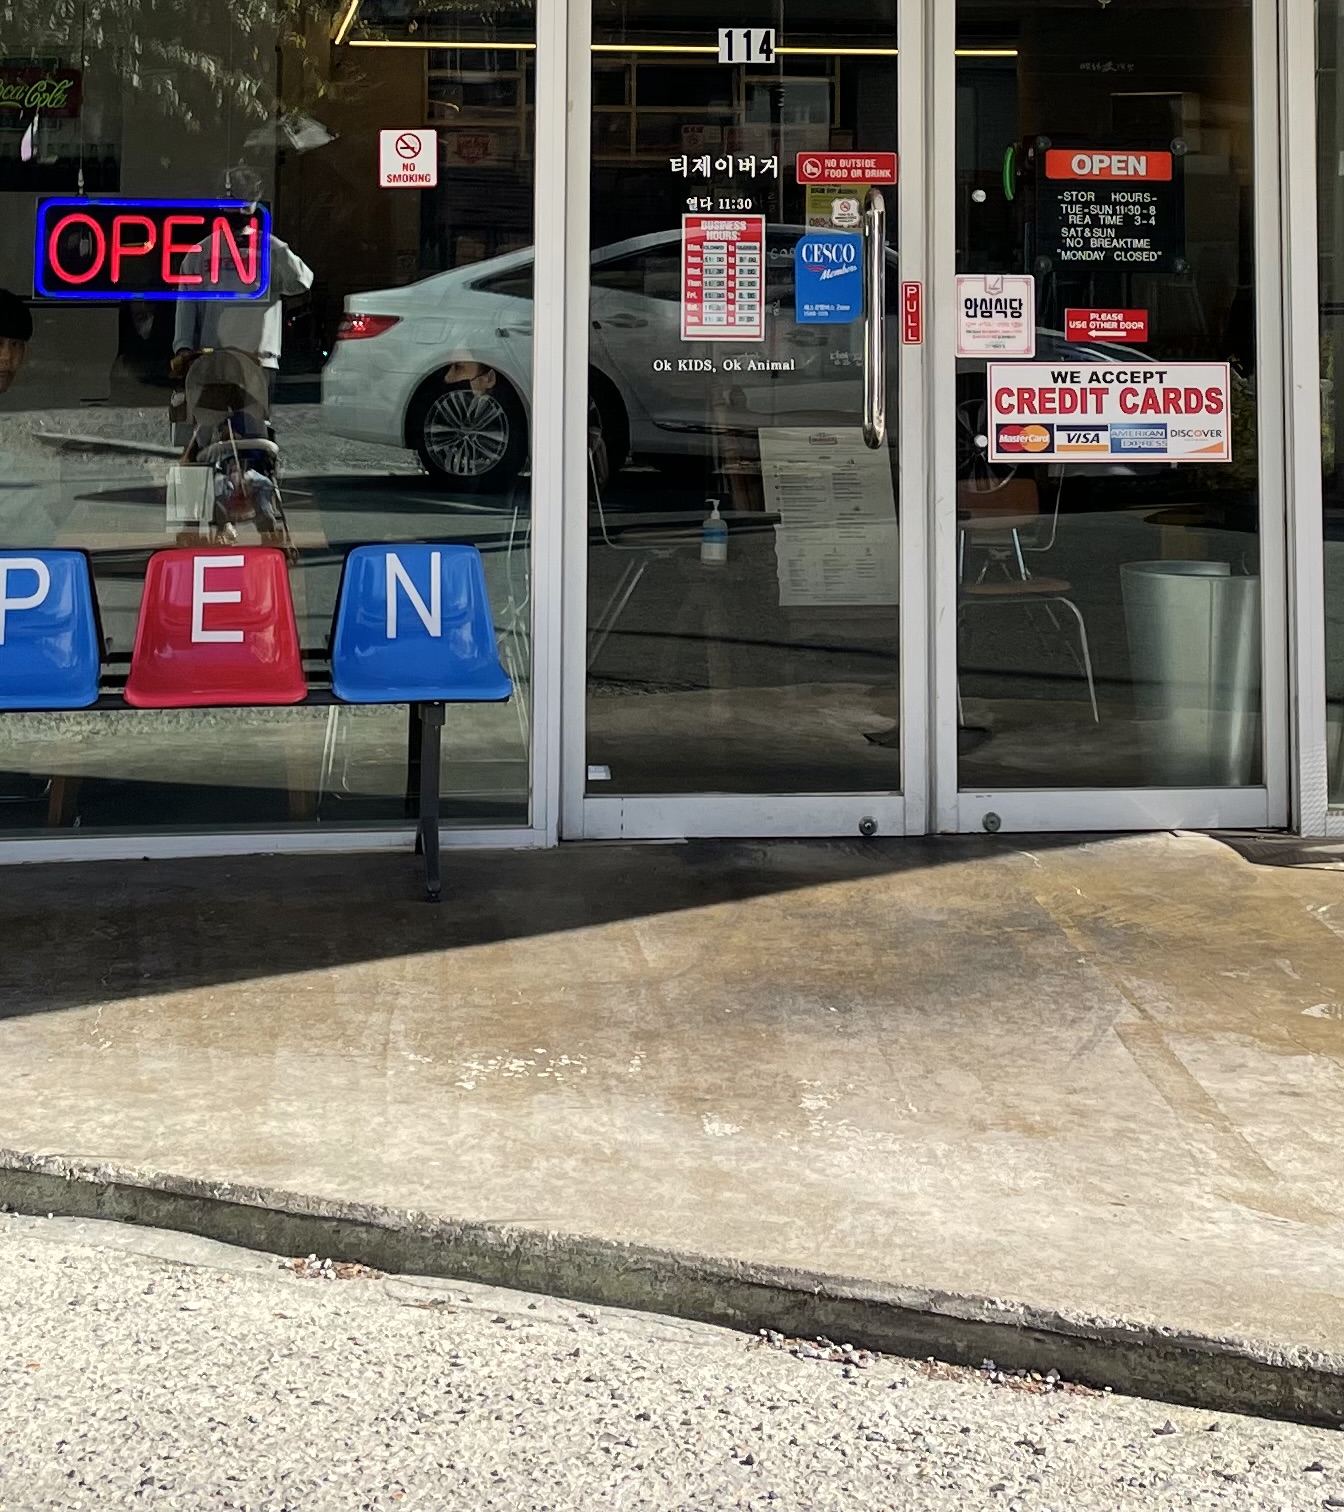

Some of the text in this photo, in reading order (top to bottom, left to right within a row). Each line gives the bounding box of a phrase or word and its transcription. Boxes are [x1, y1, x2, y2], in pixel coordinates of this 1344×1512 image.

[725, 29, 774, 61] 114
[402, 162, 416, 172] NO
[669, 154, 778, 179] 티제이버거
[824, 159, 876, 168] NO OUTSIDE
[1071, 154, 1147, 176] OPEN
[386, 173, 431, 183] SMOKING
[824, 169, 892, 178] FOOD OR DRINK
[718, 198, 752, 210] 11:30
[1060, 204, 1113, 215] TUE-SUN
[1099, 216, 1124, 226] TIME
[1134, 216, 1156, 226] 3-4
[48, 213, 258, 285] OPEN
[1090, 239, 1151, 249] BREAKTIME
[801, 243, 855, 263] CESCO
[906, 286, 918, 340] PULL
[964, 297, 1024, 319] 안심식당
[1089, 312, 1124, 321] PLEASE
[1068, 320, 1144, 330] USE OTHER DOOR
[653, 359, 672, 371] Ok
[722, 359, 742, 371] Ok
[747, 358, 795, 371] Animal
[1050, 371, 1168, 384] WE ACCEPT
[994, 387, 1224, 415] CREDIT CARDS
[999, 433, 1051, 444] MasterCard
[1065, 432, 1101, 444] VISA
[1110, 430, 1165, 438] AMERICAN
[1170, 429, 1222, 438] DISCOVER
[1122, 439, 1168, 449] EXPRESS
